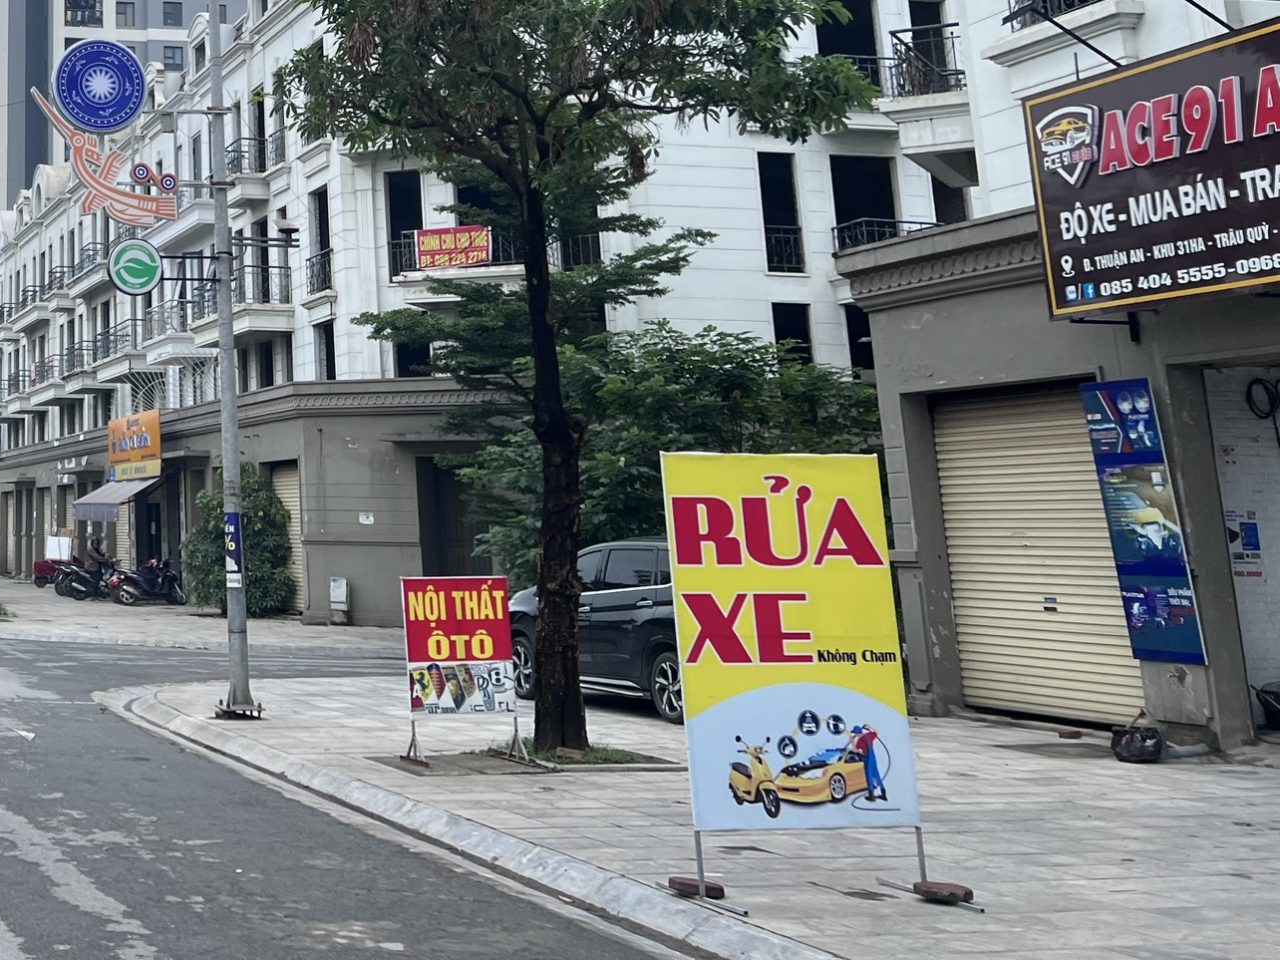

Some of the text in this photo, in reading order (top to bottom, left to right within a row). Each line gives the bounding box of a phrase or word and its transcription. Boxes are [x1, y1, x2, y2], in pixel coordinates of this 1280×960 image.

[1060, 201, 1089, 244] ĐỘ
[1088, 202, 1117, 234] XE
[1128, 188, 1180, 227] MUA
[1178, 173, 1227, 217] BÁN
[1094, 249, 1128, 270] THUẬN
[1129, 248, 1145, 263] AN
[1152, 242, 1176, 259] KHU
[1176, 236, 1207, 255] 31HA
[1100, 278, 1133, 296] 085
[1138, 271, 1173, 290] 404
[671, 474, 886, 568] RỬA
[408, 580, 505, 628] NỘI THẤT
[427, 629, 494, 660] ÔTÔ
[680, 592, 897, 666] XE Không Chạm
